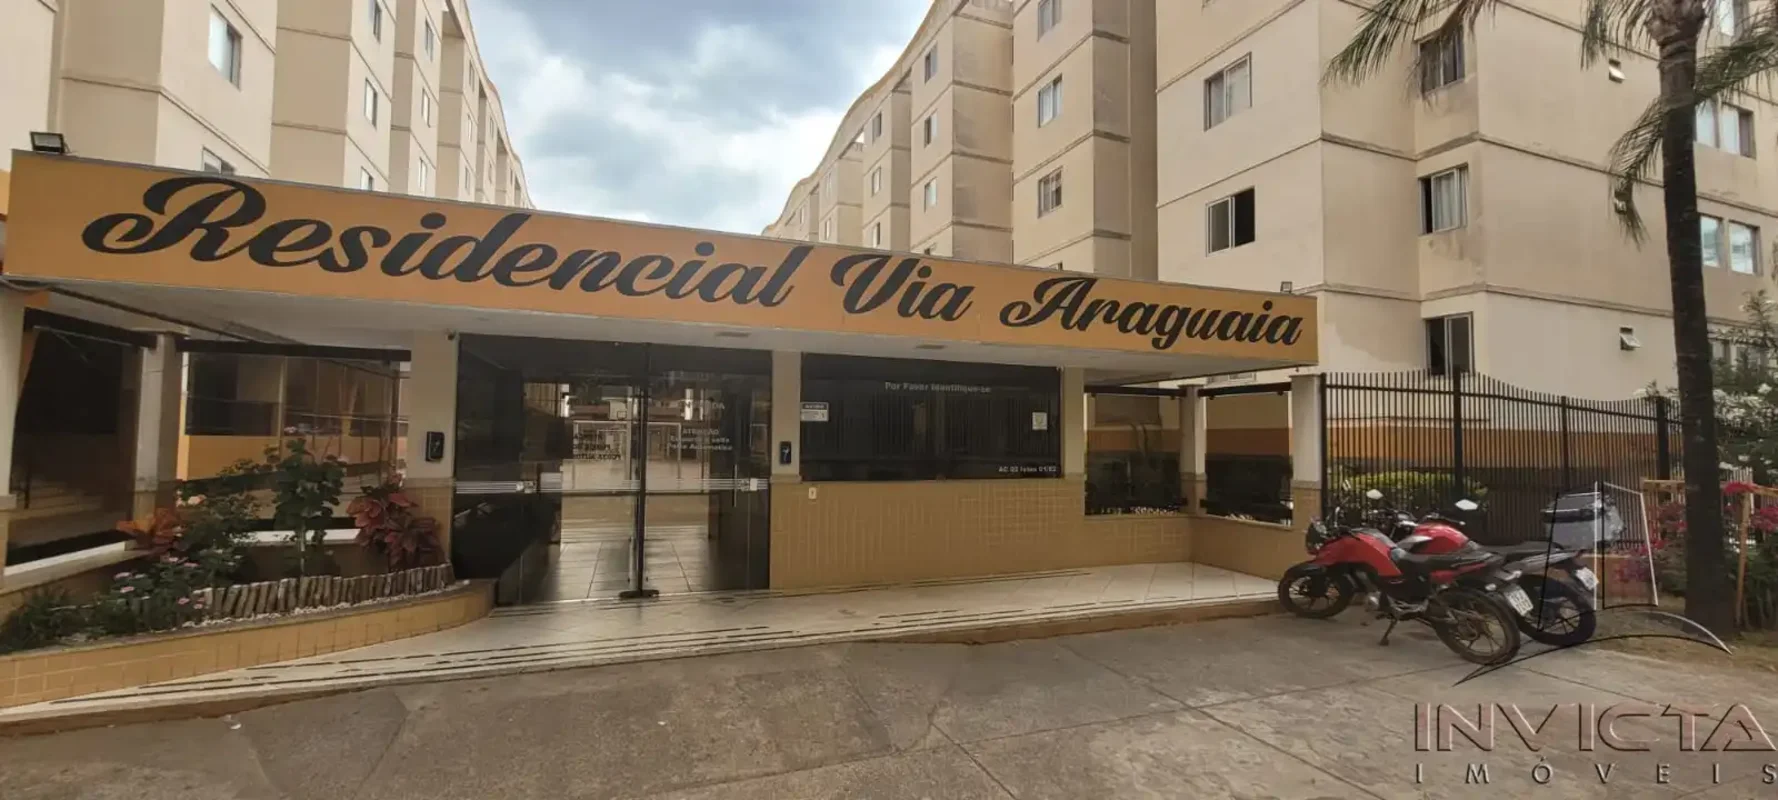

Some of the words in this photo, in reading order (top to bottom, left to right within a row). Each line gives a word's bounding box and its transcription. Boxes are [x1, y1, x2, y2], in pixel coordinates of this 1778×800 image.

[80, 176, 811, 309] Residencial
[830, 252, 976, 322] Via
[999, 276, 1304, 350] Araguaia
[884, 380, 901, 391] Por
